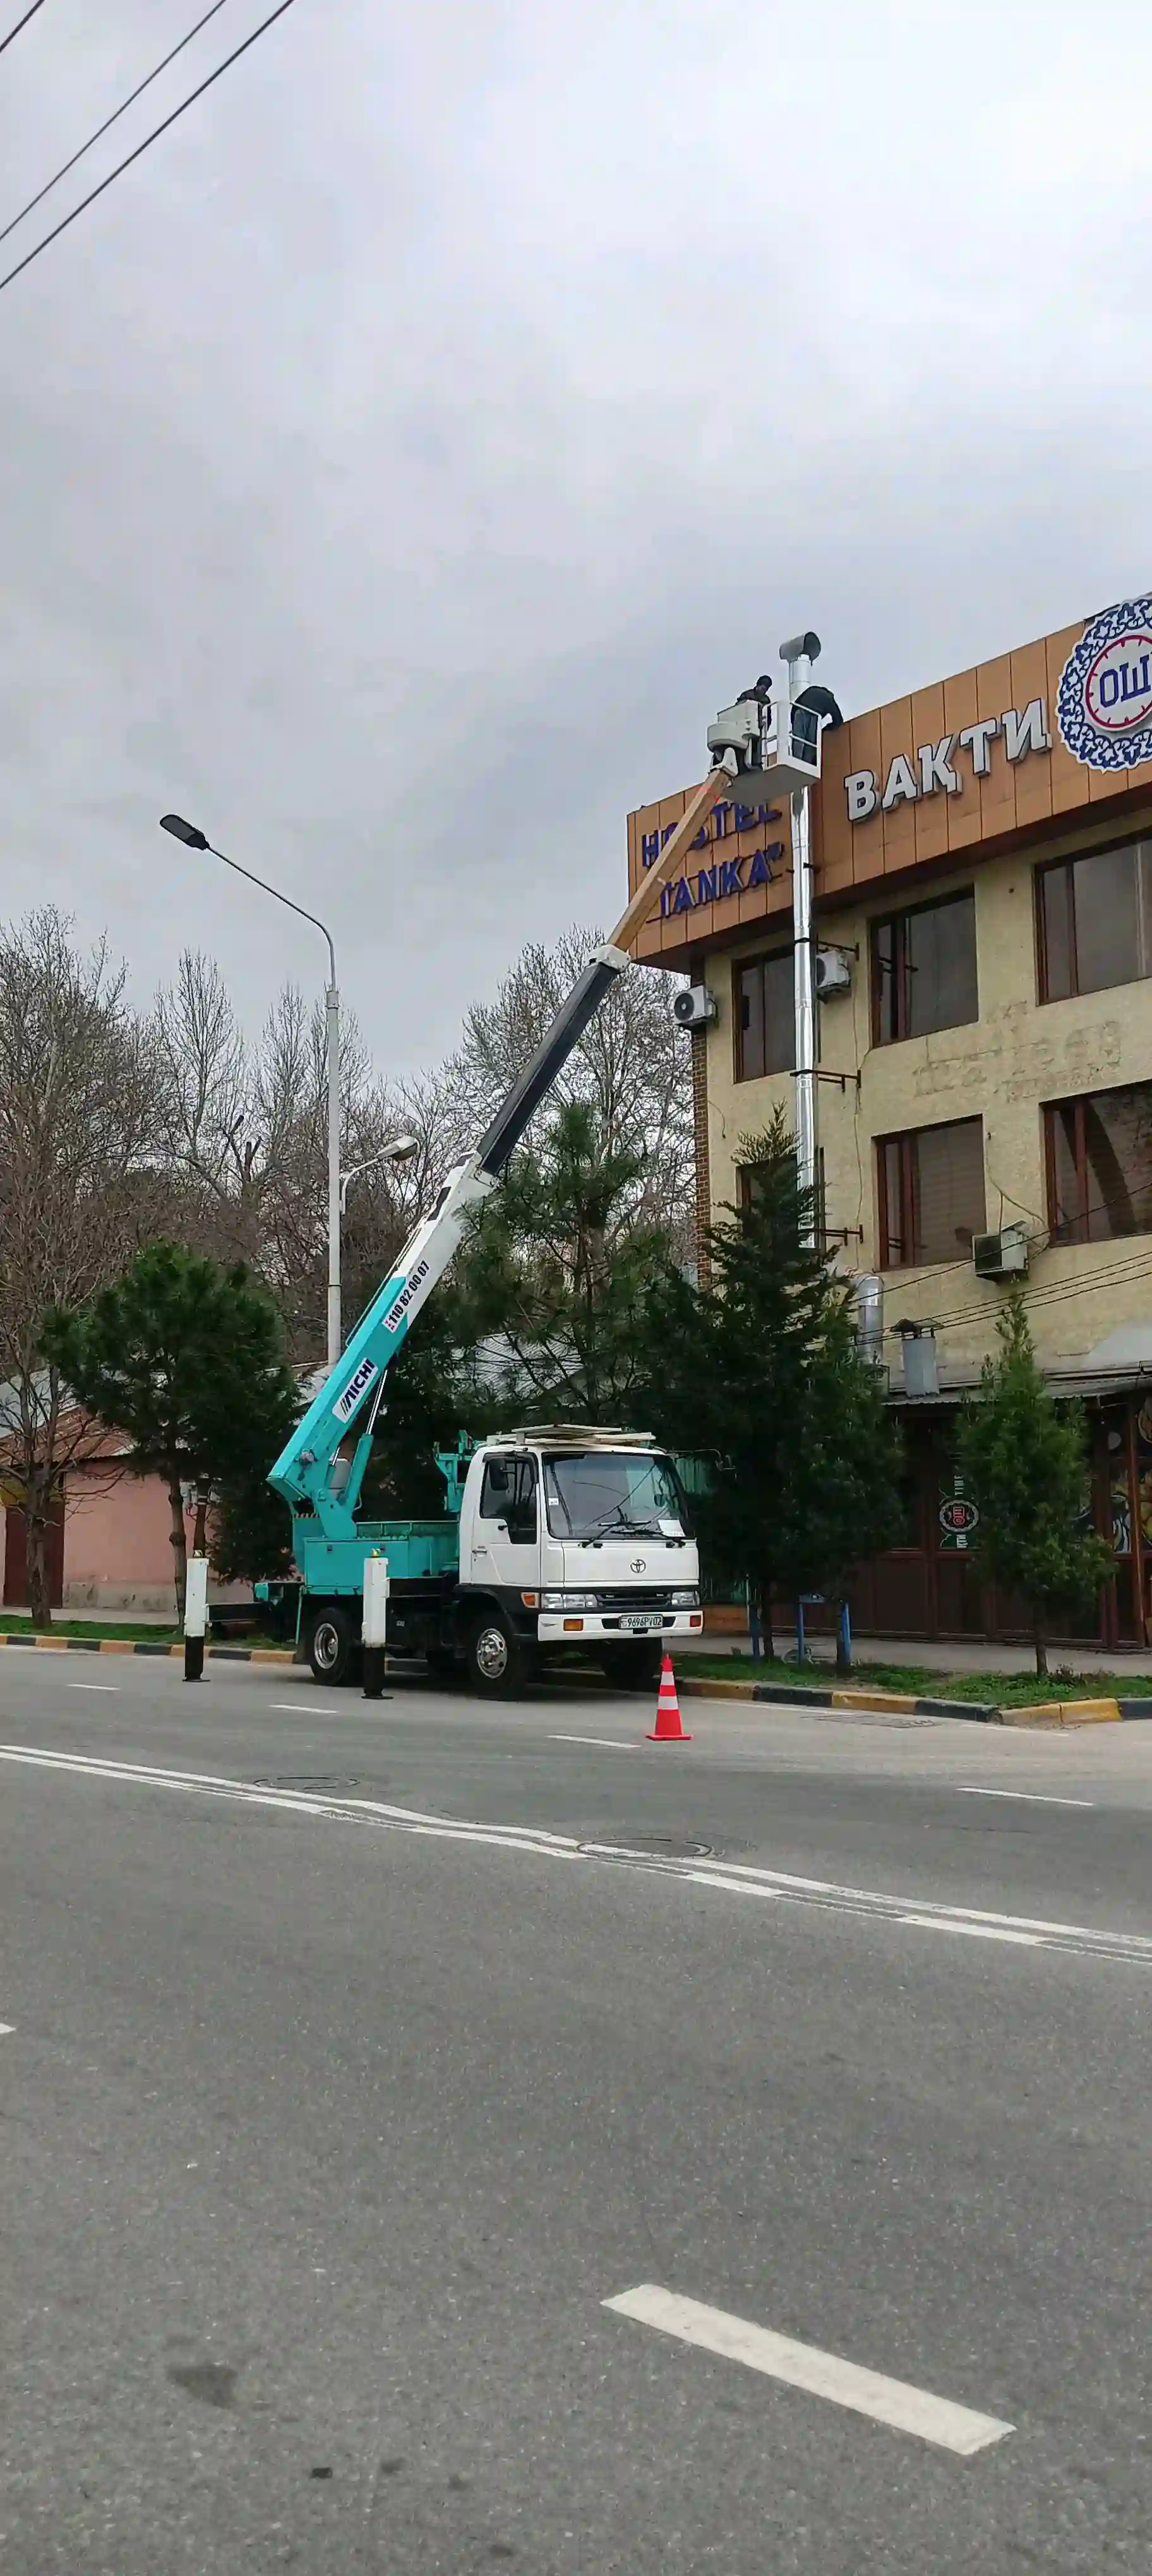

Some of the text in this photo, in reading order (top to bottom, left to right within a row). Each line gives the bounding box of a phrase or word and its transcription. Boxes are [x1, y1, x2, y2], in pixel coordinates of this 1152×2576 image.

[1100, 654, 1151, 708] ОШ
[389, 1260, 429, 1324] 110 82 00 07
[343, 1358, 376, 1410] AICHI
